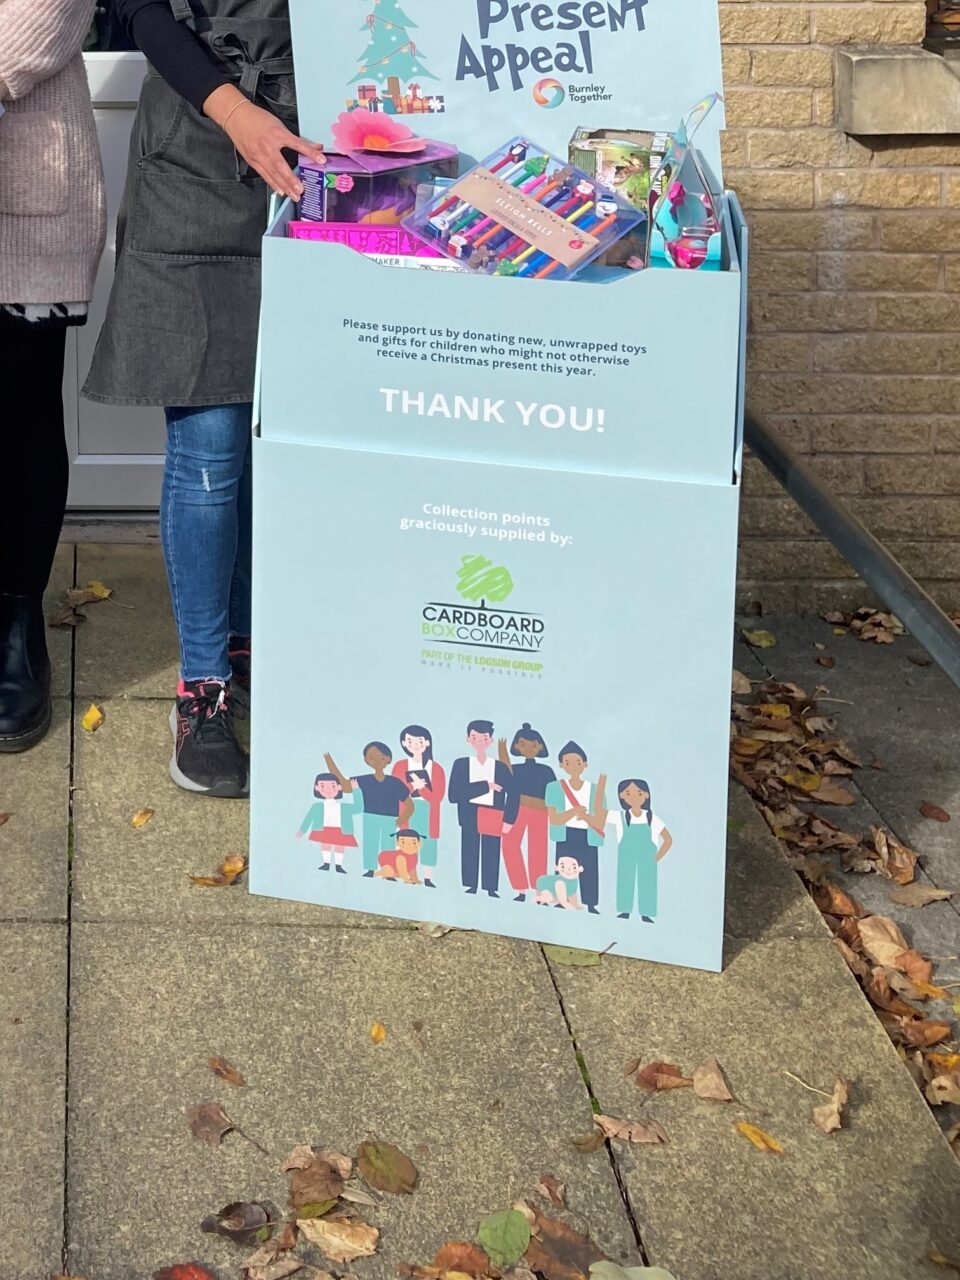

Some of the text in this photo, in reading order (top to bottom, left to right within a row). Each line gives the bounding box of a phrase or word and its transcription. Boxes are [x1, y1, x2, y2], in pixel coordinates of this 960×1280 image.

[455, 30, 593, 92] Appeal
[568, 84, 606, 95] Burnley
[568, 93, 612, 103] Together
[368, 257, 400, 265] MAKER
[343, 319, 379, 331] Please
[382, 323, 427, 335] support
[446, 329, 459, 340] by
[463, 330, 515, 346] donating
[519, 336, 546, 347] new,
[550, 339, 618, 353] unwrapped
[622, 344, 647, 355] toys
[358, 334, 629, 366] and gifts for children who might not otherwise
[377, 348, 417, 360] receive
[431, 353, 489, 367] Christmas
[493, 359, 537, 371] present
[541, 363, 563, 373] this
[566, 366, 596, 376] year.
[379, 387, 605, 433] THANK YOU!
[423, 503, 550, 527] Collection points
[400, 518, 573, 547] graciously supplied by:
[423, 607, 545, 633] CARDBOARD
